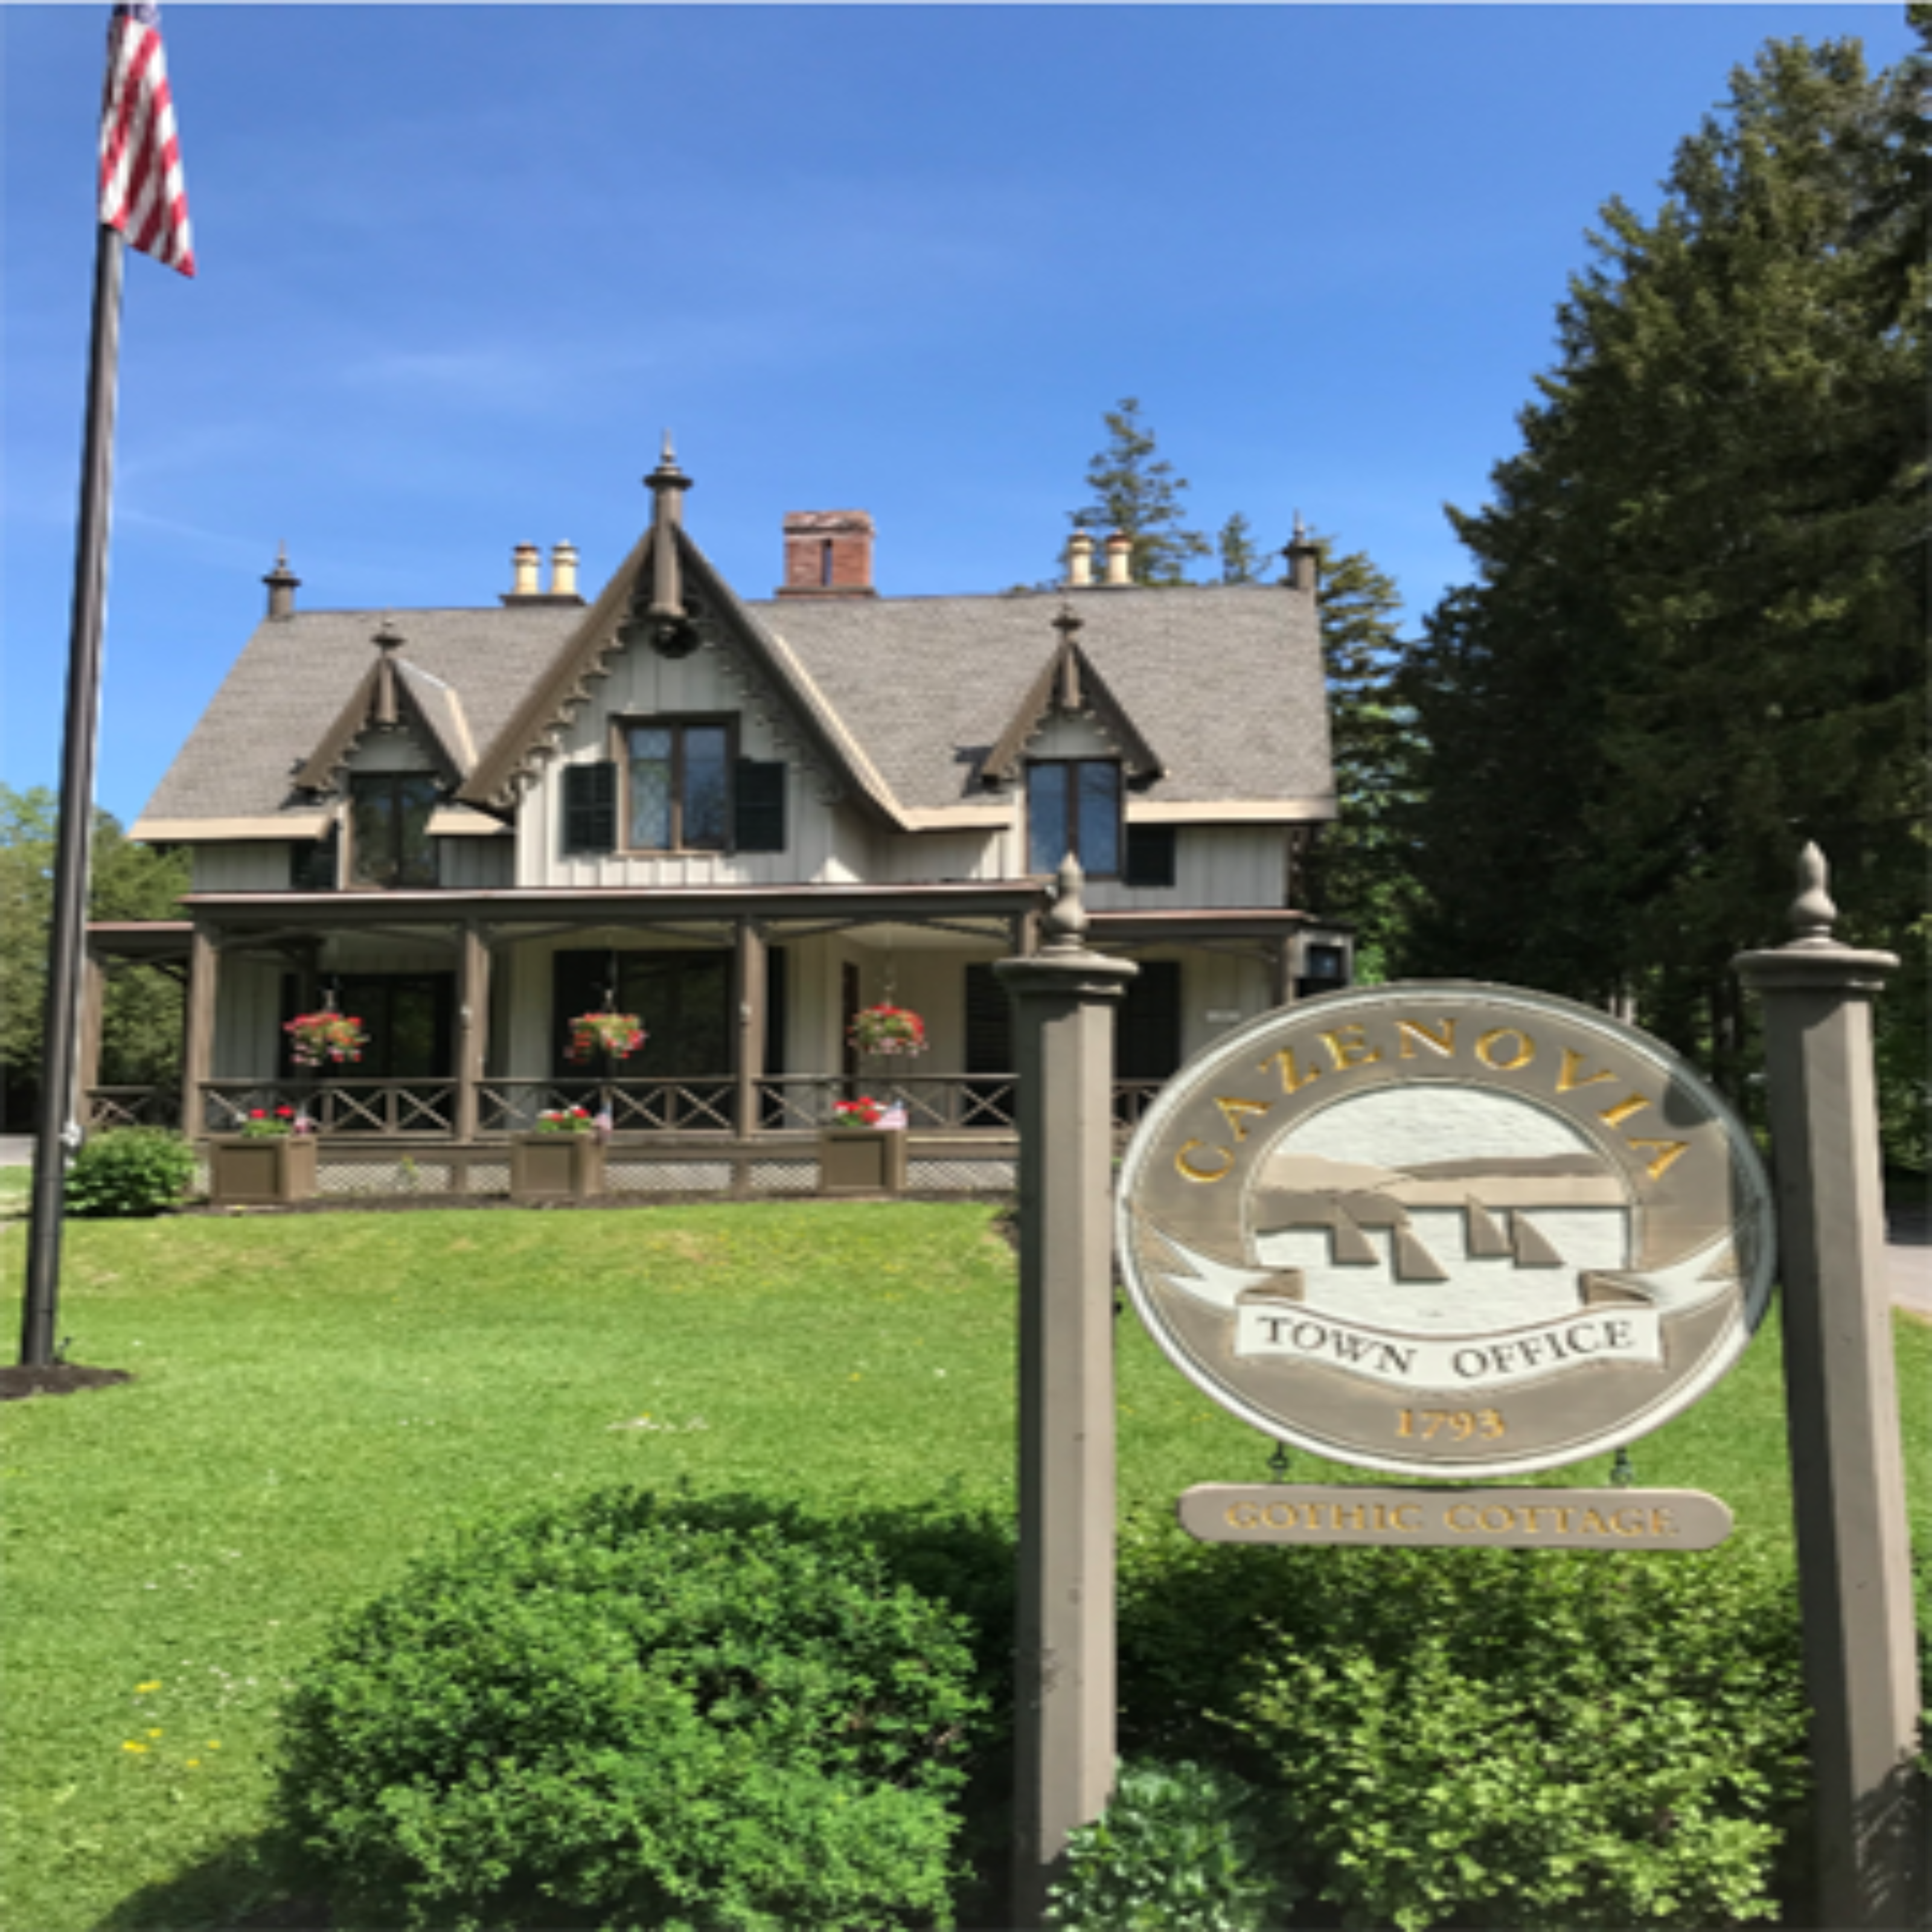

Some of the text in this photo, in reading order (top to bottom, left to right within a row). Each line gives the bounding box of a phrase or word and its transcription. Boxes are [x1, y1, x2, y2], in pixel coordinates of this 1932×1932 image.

[1174, 1017, 1692, 1183] CAZENOVIA
[1256, 1316, 1636, 1379] TOWN OFFICE
[1395, 1408, 1506, 1442] 1793
[1224, 1501, 1680, 1538] GOTHIC COTTAGE
